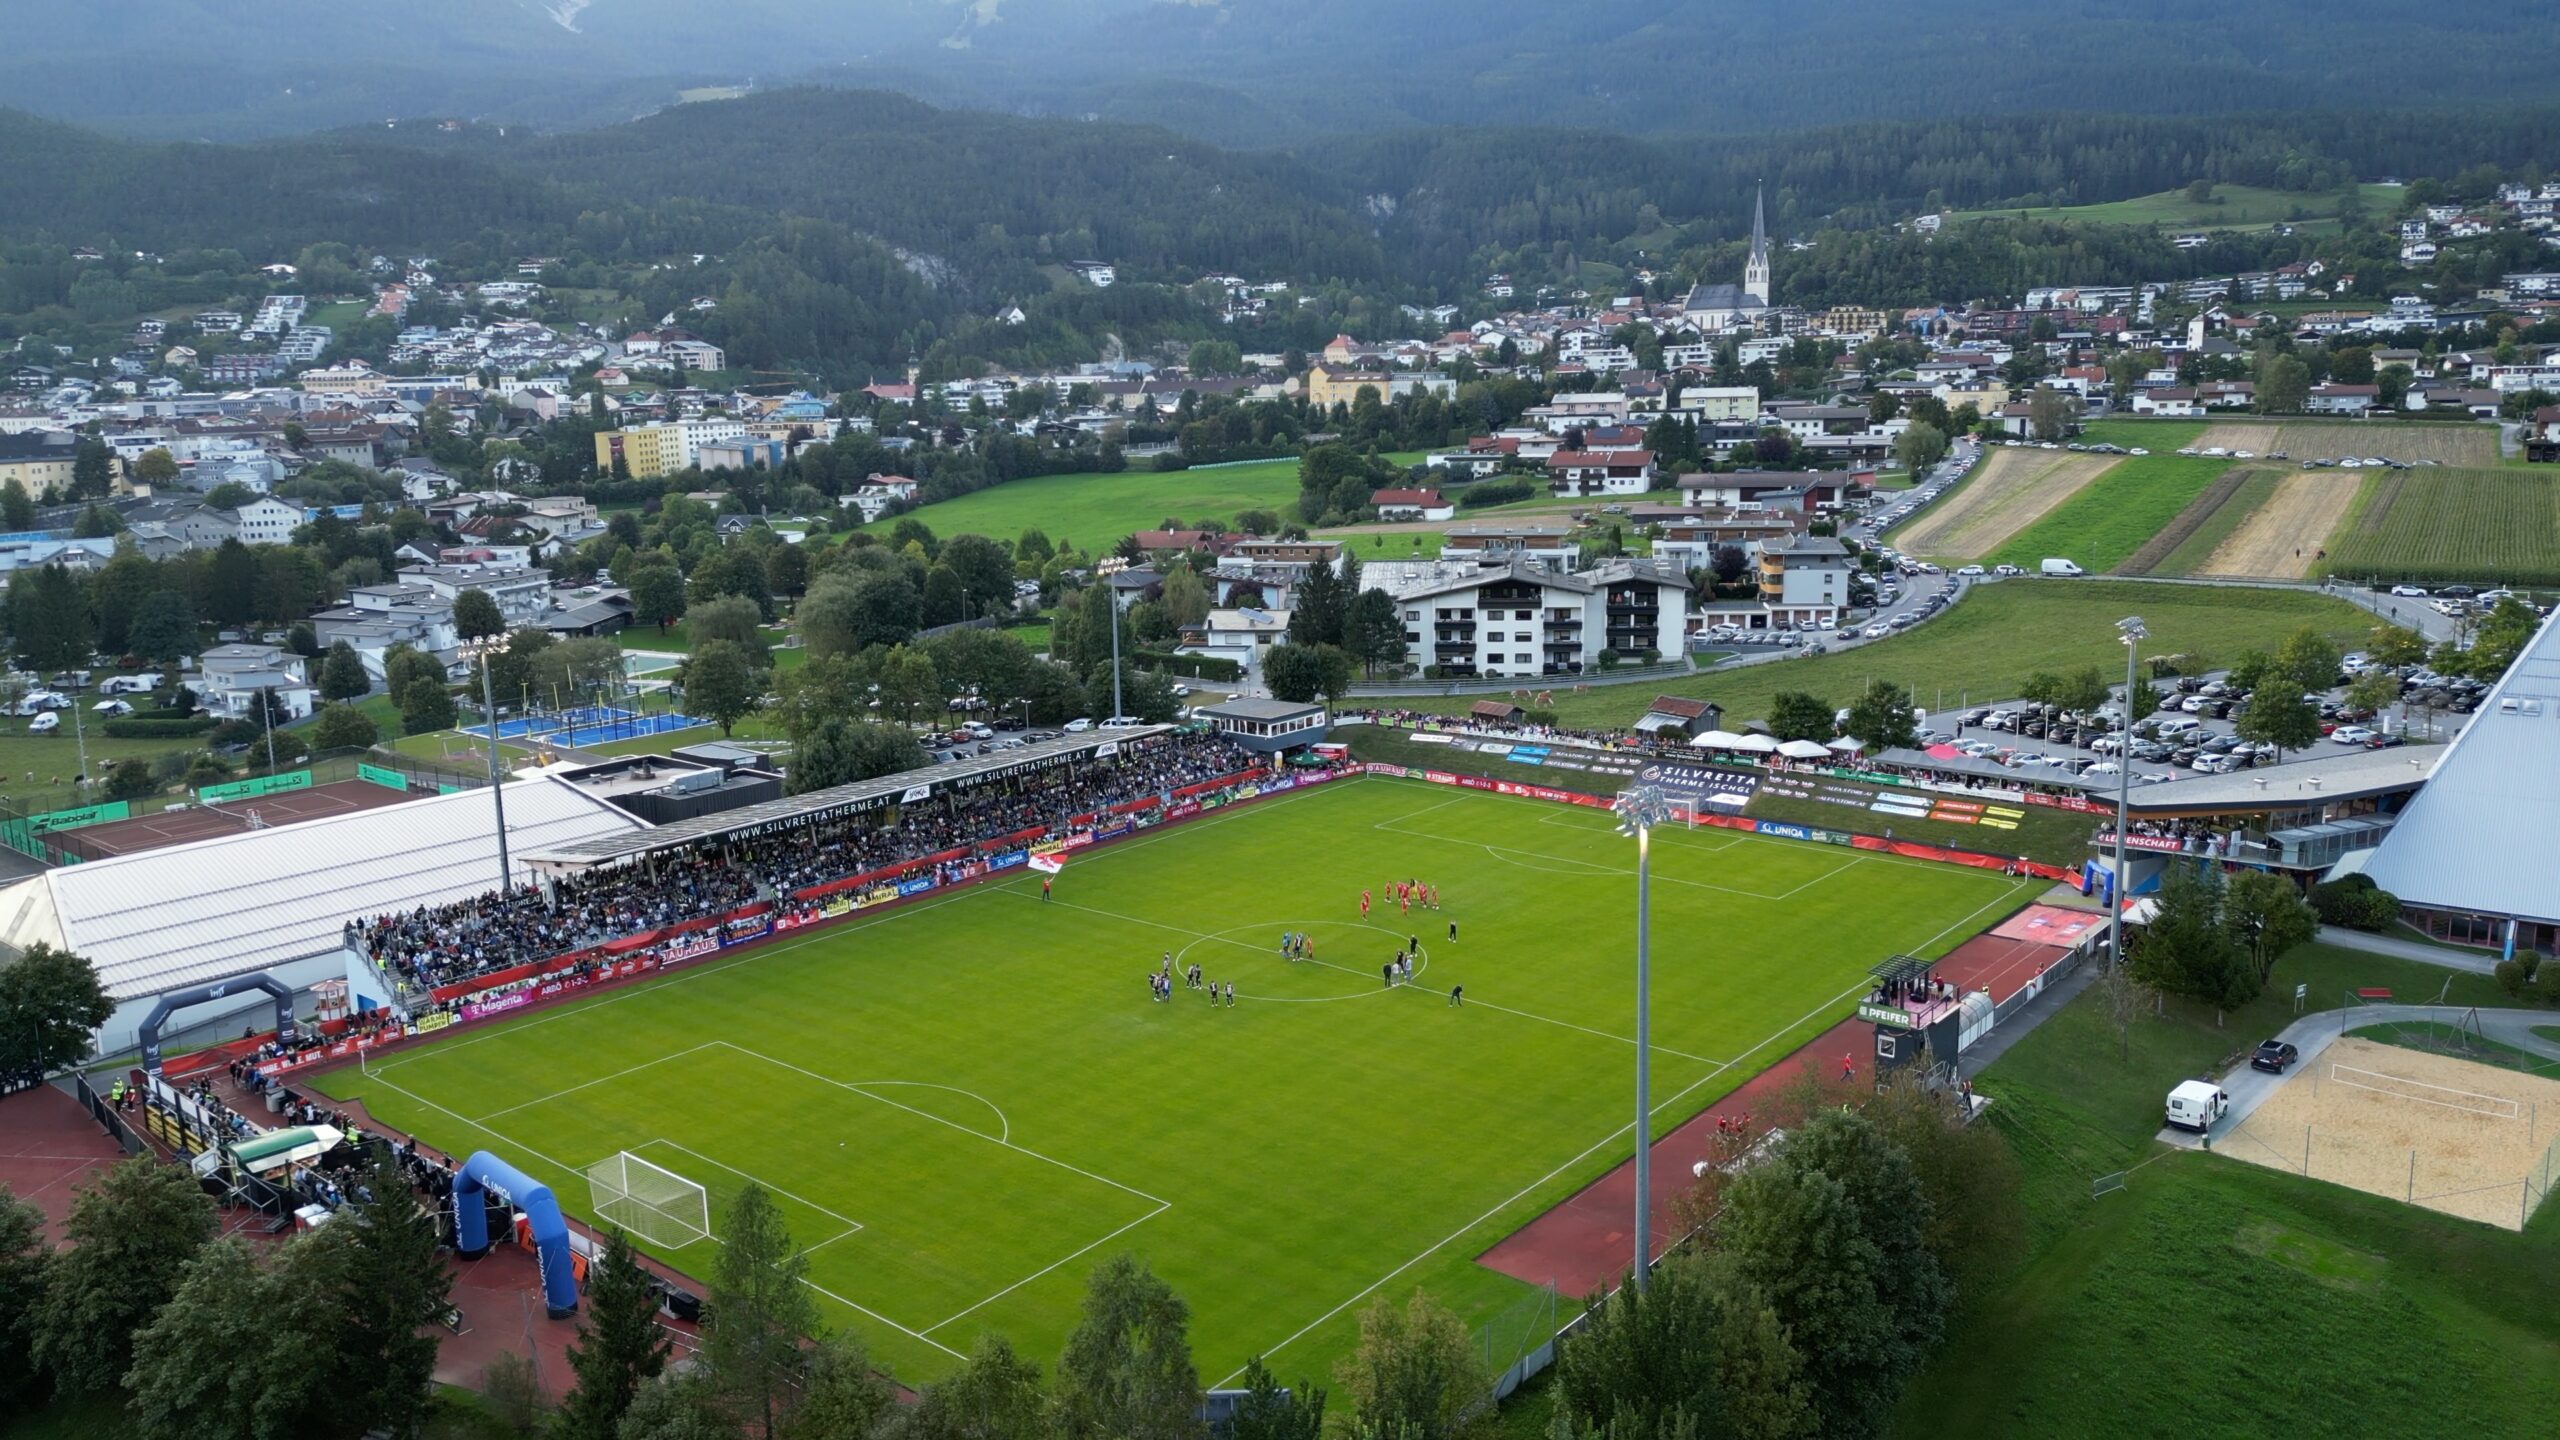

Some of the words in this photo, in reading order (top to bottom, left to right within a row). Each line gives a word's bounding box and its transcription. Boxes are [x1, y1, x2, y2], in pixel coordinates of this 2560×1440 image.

[957, 750, 1086, 788] WWW.SILVRETTATHERME.AT
[1664, 767, 1756, 786] SILVRETTA
[1660, 777, 1706, 788] THERME
[1709, 783, 1750, 794] ISCHGL
[51, 811, 98, 826] Babolat
[729, 796, 890, 843] WWW.SILVRETTATHERME.AT
[1775, 826, 1804, 838] UNIQA
[2105, 834, 2177, 849] LEENSCHAFT
[909, 881, 929, 892] UNIQA
[859, 888, 898, 906] AMIRAL
[481, 994, 523, 1012] Magenta
[1869, 1008, 1909, 1025] PFEIFER
[305, 1051, 324, 1062] MUT.
[453, 1192, 462, 1229] UNIQA
